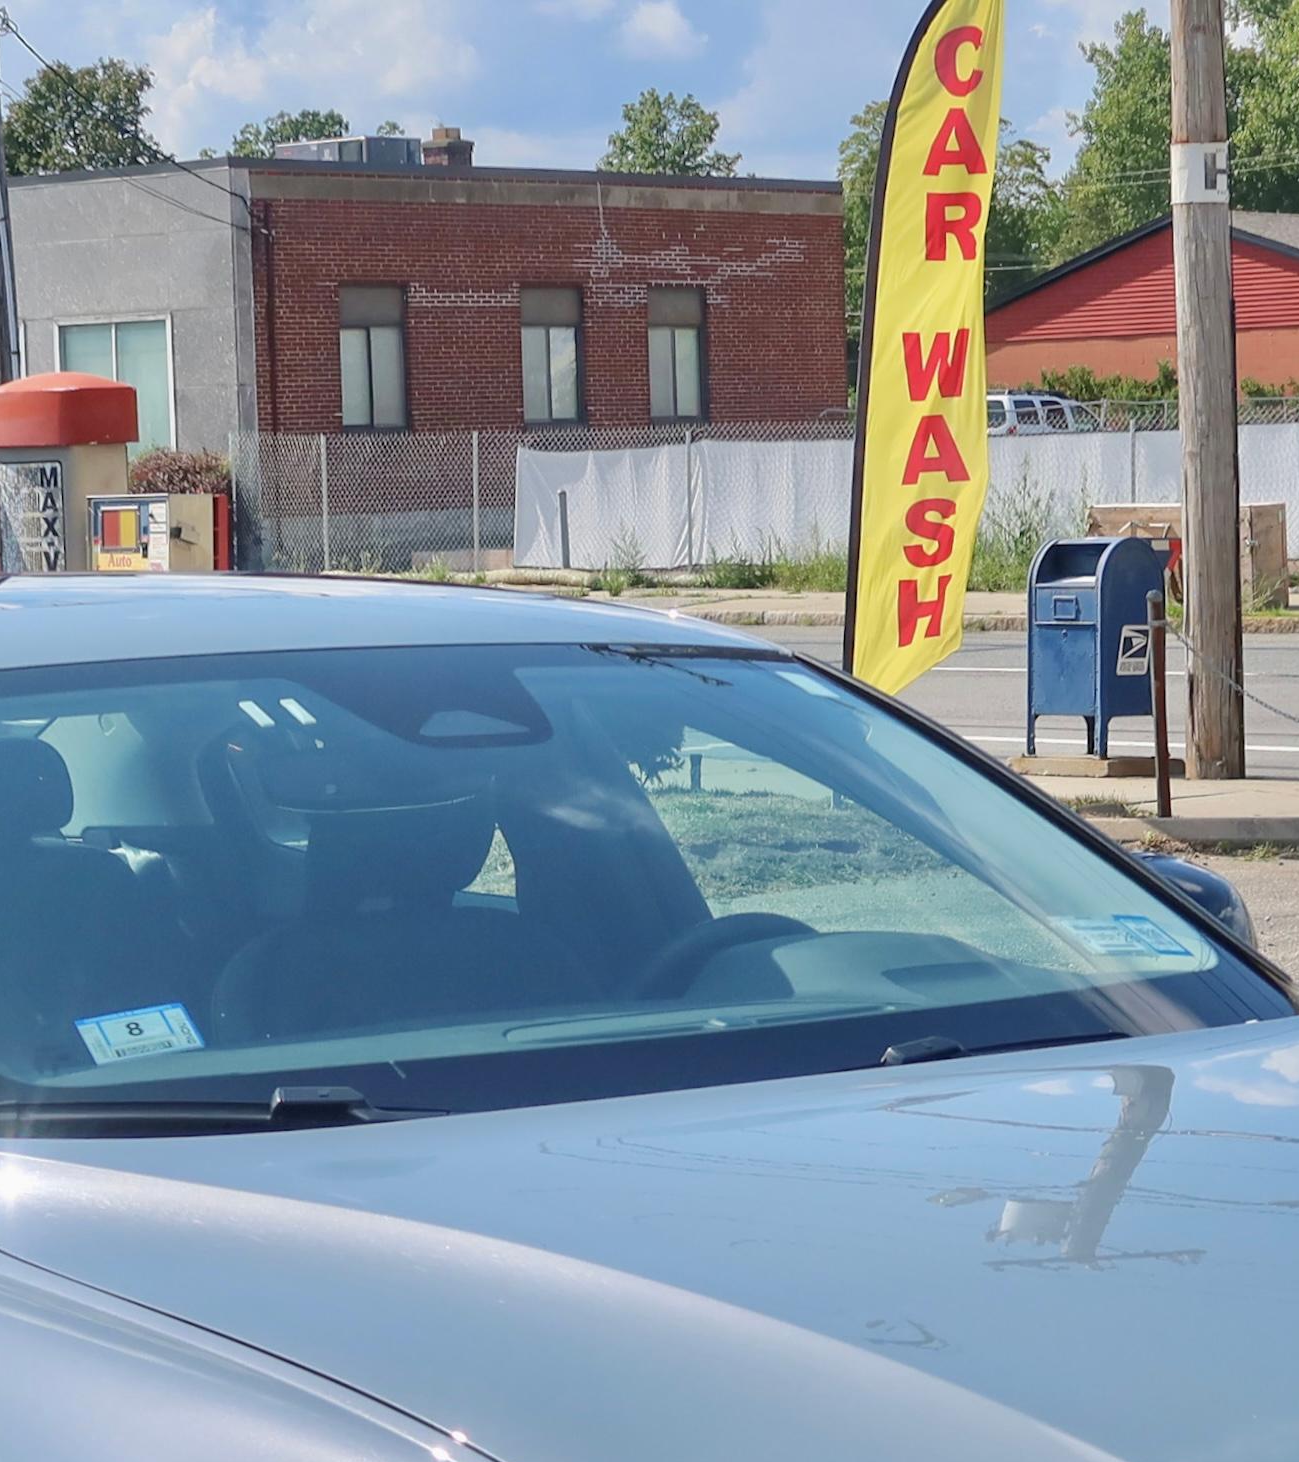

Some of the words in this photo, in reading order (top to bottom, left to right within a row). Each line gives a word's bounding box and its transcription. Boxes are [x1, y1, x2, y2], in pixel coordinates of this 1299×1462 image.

[922, 25, 987, 262] CAR
[897, 328, 970, 648] WASH
[107, 553, 132, 568] Auto
[125, 1022, 144, 1037] 8
